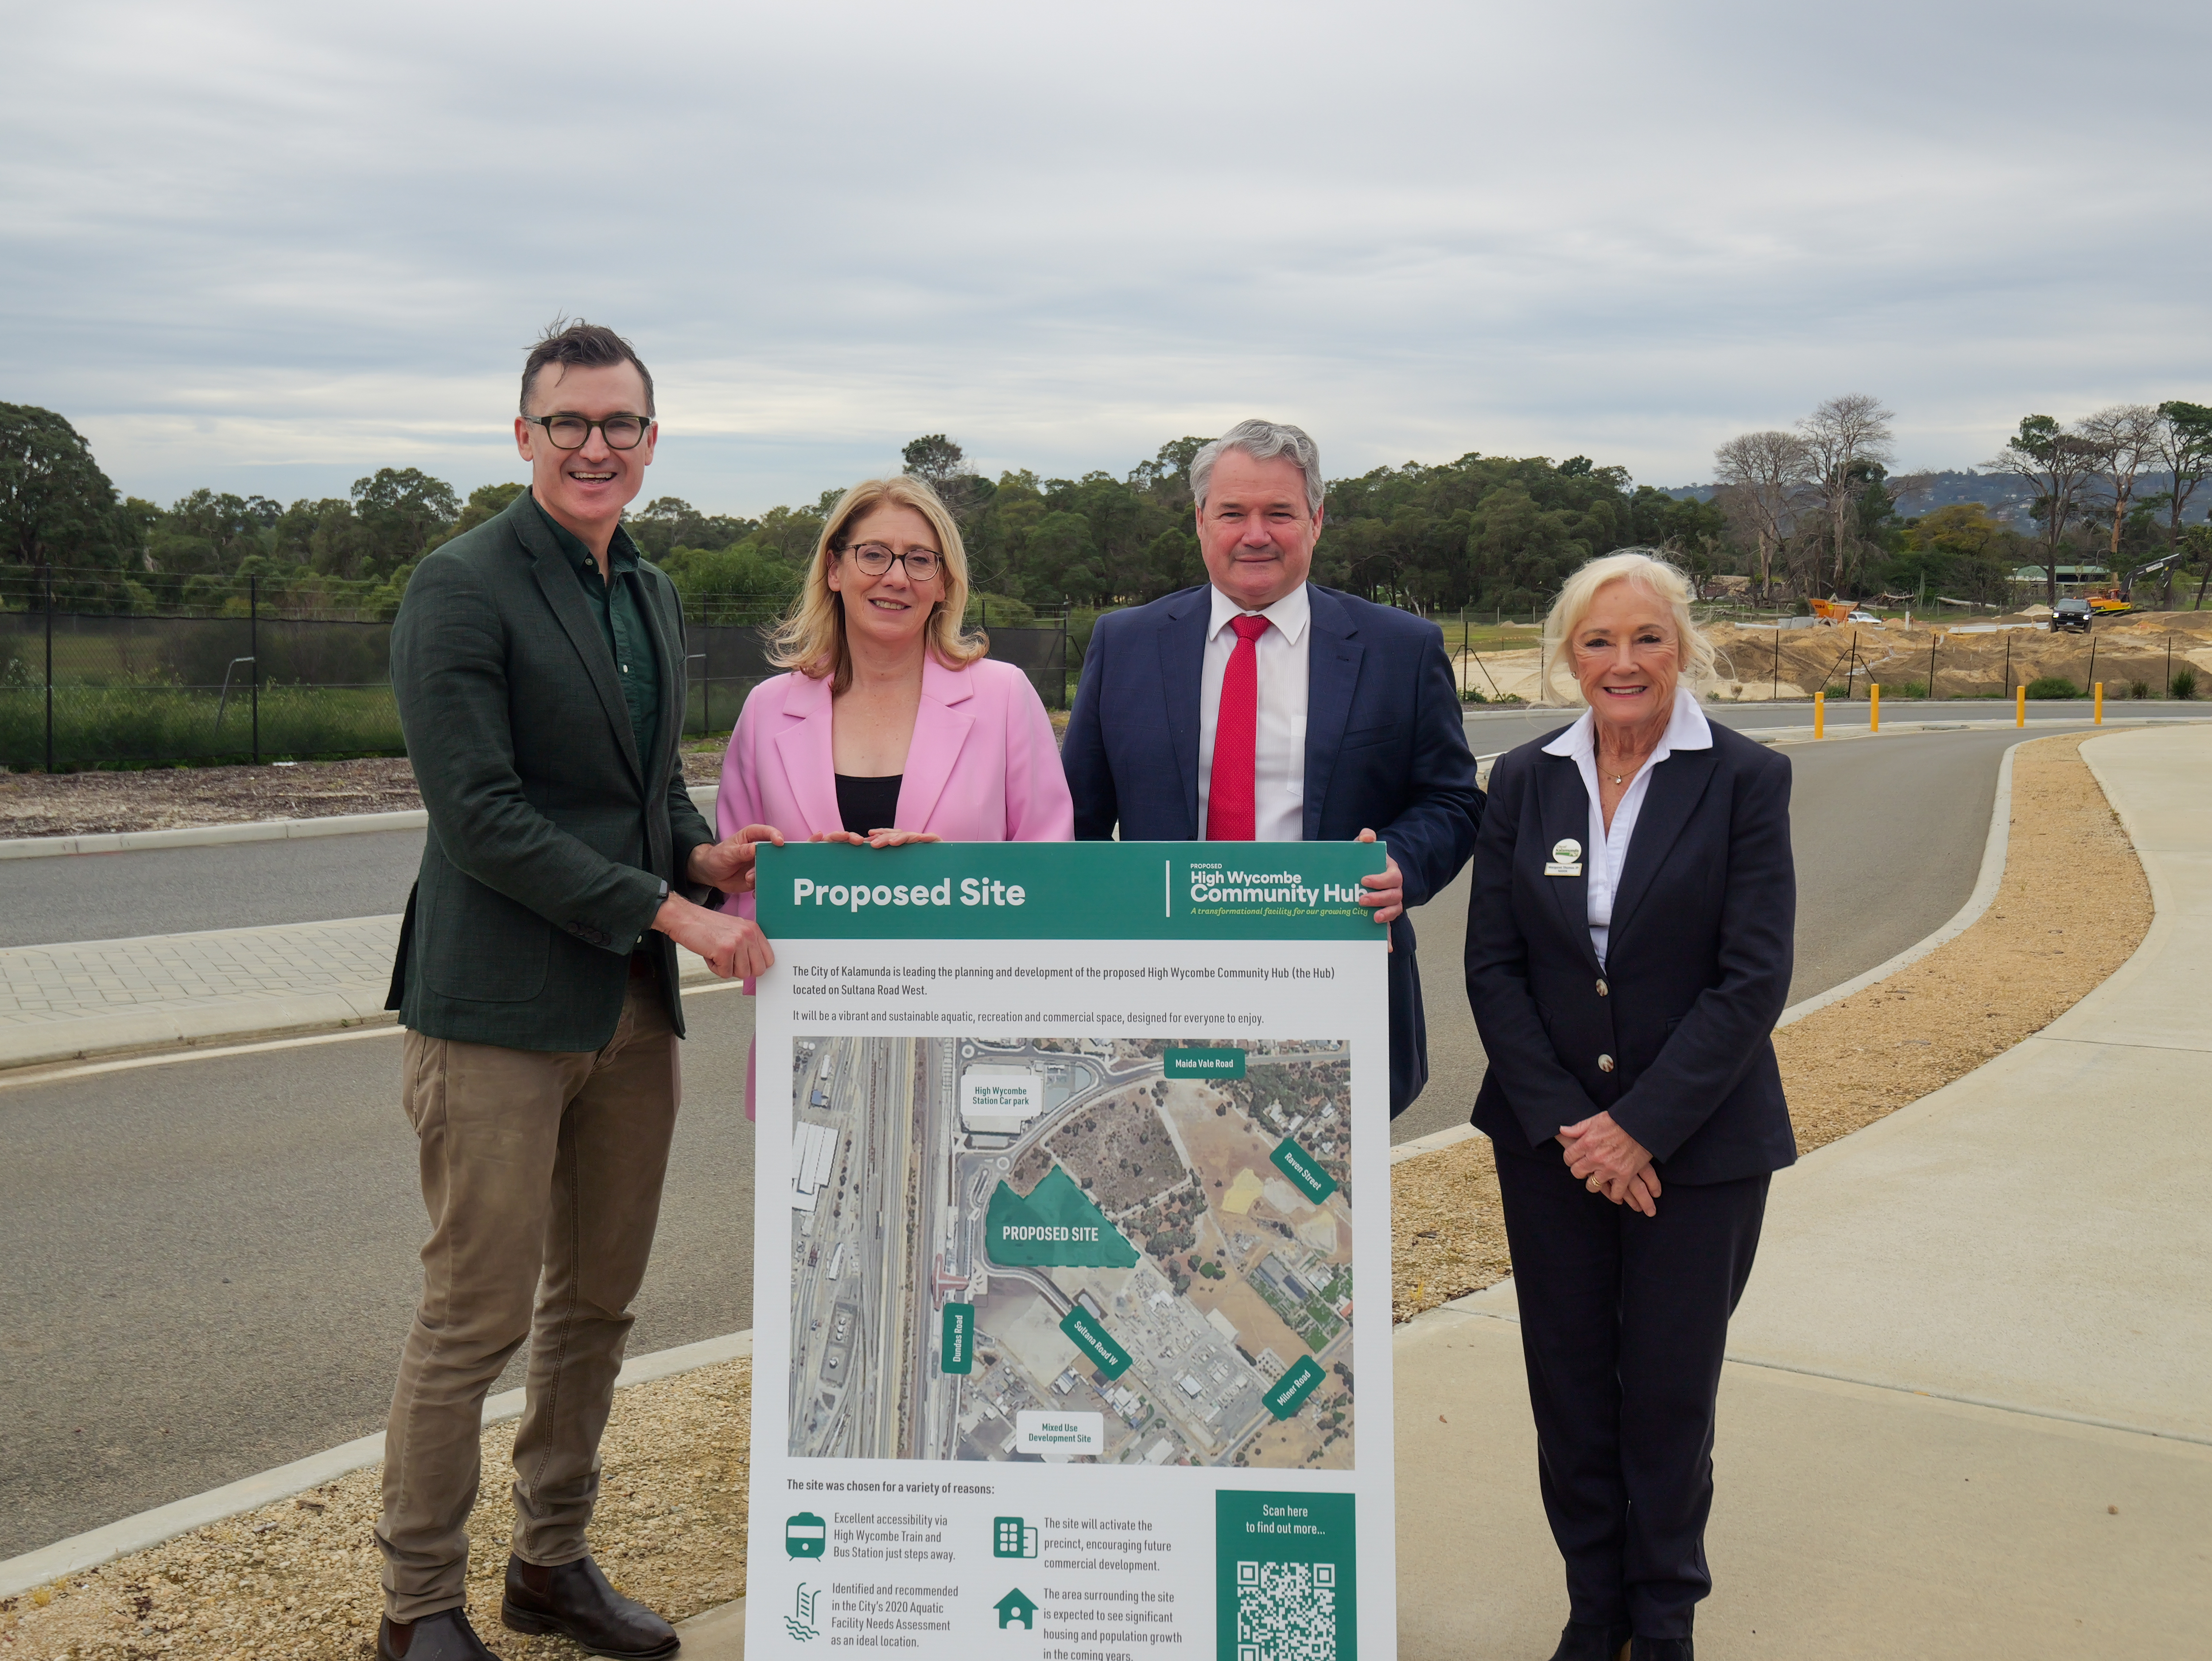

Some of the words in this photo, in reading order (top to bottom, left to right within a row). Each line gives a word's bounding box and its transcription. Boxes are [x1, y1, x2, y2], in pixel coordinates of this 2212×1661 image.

[1191, 871, 1224, 887] High
[1226, 871, 1302, 887] Wycombe
[794, 877, 951, 913] Proposed
[959, 877, 1025, 906] Site
[1190, 883, 1319, 907] Community
[1324, 883, 1368, 902] Hub
[1197, 907, 1263, 916] transformational
[1263, 907, 1292, 917] facility
[1292, 907, 1305, 917] for
[1319, 907, 1351, 917] growing
[1352, 907, 1368, 917] City
[792, 966, 809, 976] The
[811, 966, 828, 979] City
[830, 966, 839, 976] of
[842, 966, 891, 976] Kalamunda
[893, 966, 901, 976] is
[903, 966, 936, 980] leading
[938, 966, 952, 977] the
[955, 966, 993, 980] planning
[996, 967, 1012, 977] and
[1014, 967, 1073, 980] development
[1075, 967, 1084, 977] of
[1086, 967, 1101, 977] the
[1103, 967, 1145, 980] proposed
[1148, 967, 1168, 980] High
[1170, 967, 1215, 980] Wycombe
[1218, 967, 1269, 981] Community
[1272, 968, 1289, 978] Hub
[1292, 967, 1311, 979] (the
[1313, 967, 1335, 980] Hub)
[793, 984, 826, 995] located
[842, 984, 875, 995] Sultana
[878, 984, 899, 995] Road
[902, 985, 927, 995] West.
[793, 1010, 799, 1020] It
[801, 1010, 817, 1020] will
[819, 1010, 829, 1021] be
[838, 1010, 869, 1021] vibrant
[871, 1011, 886, 1021] and
[889, 1011, 939, 1021] sustainable
[941, 1011, 975, 1024] aquatic,
[978, 1011, 1022, 1022] recreation
[1025, 1011, 1040, 1022] and
[1043, 1011, 1094, 1022] commercial
[1096, 1015, 1125, 1025] space,
[1127, 1012, 1167, 1026] designed
[1169, 1012, 1182, 1023] for
[1184, 1015, 1225, 1026] everyone
[1227, 1013, 1235, 1023] to
[1238, 1012, 1264, 1026] enjoy.
[1176, 1059, 1197, 1068] Maida
[1198, 1059, 1214, 1068] Vale
[1215, 1059, 1233, 1068] Road
[975, 1086, 991, 1097] High
[992, 1086, 1027, 1097] Wycombe
[1013, 1097, 1029, 1107] park
[1284, 1152, 1304, 1174] Raven
[1301, 1169, 1322, 1191] Street
[1003, 1226, 1069, 1241] PROPOSED
[1071, 1227, 1098, 1241] SITE
[954, 1315, 963, 1334] Road
[953, 1334, 962, 1362] Dundas
[1074, 1321, 1096, 1346] Sultana
[1094, 1341, 1112, 1360] Road
[1108, 1355, 1118, 1365] W
[1277, 1385, 1297, 1406] Milner
[1293, 1369, 1311, 1388] Road
[1042, 1423, 1063, 1431] Mixed
[1064, 1424, 1078, 1432] Use
[1029, 1433, 1075, 1444] Development
[1077, 1434, 1091, 1443] Site
[787, 1479, 804, 1490] The
[806, 1479, 823, 1490] site
[826, 1482, 844, 1491] was
[847, 1480, 880, 1491] chosen
[882, 1481, 896, 1492] for
[906, 1482, 939, 1496] variety
[942, 1482, 951, 1493] of
[953, 1486, 994, 1494] reasons:
[1263, 1504, 1285, 1517] Scan
[1287, 1505, 1308, 1517] here
[834, 1512, 874, 1524] Excellent
[877, 1514, 932, 1529] accessibility
[935, 1515, 947, 1526] via
[1044, 1517, 1060, 1529] The
[1063, 1518, 1079, 1529] site
[1081, 1518, 1098, 1529] will
[1100, 1519, 1135, 1530] activate
[1138, 1520, 1152, 1531] the
[1246, 1521, 1255, 1533] to
[1257, 1521, 1274, 1533] find
[1277, 1522, 1292, 1534] out
[1293, 1525, 1325, 1535] more...
[834, 1529, 854, 1543] High
[856, 1529, 899, 1544] Wycombe
[901, 1531, 923, 1542] Train
[925, 1532, 941, 1542] and
[1044, 1537, 1083, 1552] precinct,
[1086, 1539, 1141, 1554] encouraging
[1144, 1540, 1171, 1551] future
[834, 1546, 850, 1557] Bus
[852, 1547, 883, 1558] Station
[885, 1547, 902, 1561] just
[904, 1548, 928, 1562] steps
[931, 1551, 955, 1563] away.
[1044, 1558, 1097, 1569] commercial
[1099, 1559, 1160, 1573] development.
[833, 1583, 874, 1595] Identified
[877, 1584, 893, 1595] and
[895, 1585, 958, 1596] recommended
[1044, 1588, 1059, 1599] The
[1062, 1591, 1082, 1600] area
[1084, 1590, 1138, 1605] surrounding
[1141, 1591, 1155, 1602] the
[1158, 1591, 1174, 1603] site
[832, 1599, 840, 1610] in
[842, 1600, 856, 1611] the
[859, 1600, 883, 1615] City's
[885, 1601, 908, 1612] 2020
[910, 1602, 943, 1616] Aquatic
[1044, 1608, 1051, 1619] is
[1054, 1609, 1094, 1622] expected
[1097, 1610, 1105, 1621] to
[1107, 1613, 1123, 1621] see
[1125, 1610, 1173, 1625] significant
[832, 1617, 864, 1632] Facility
[866, 1618, 894, 1629] Needs
[896, 1618, 950, 1630] Assessment
[831, 1637, 841, 1645] as
[843, 1637, 854, 1645] an
[857, 1634, 878, 1646] ideal
[881, 1635, 919, 1647] location.
[1044, 1628, 1079, 1643] housing
[1081, 1630, 1097, 1640] and
[1100, 1630, 1148, 1644] population
[1150, 1632, 1182, 1645] growth
[1044, 1648, 1051, 1659] in
[1054, 1649, 1068, 1660] the
[1071, 1649, 1103, 1661] coming
